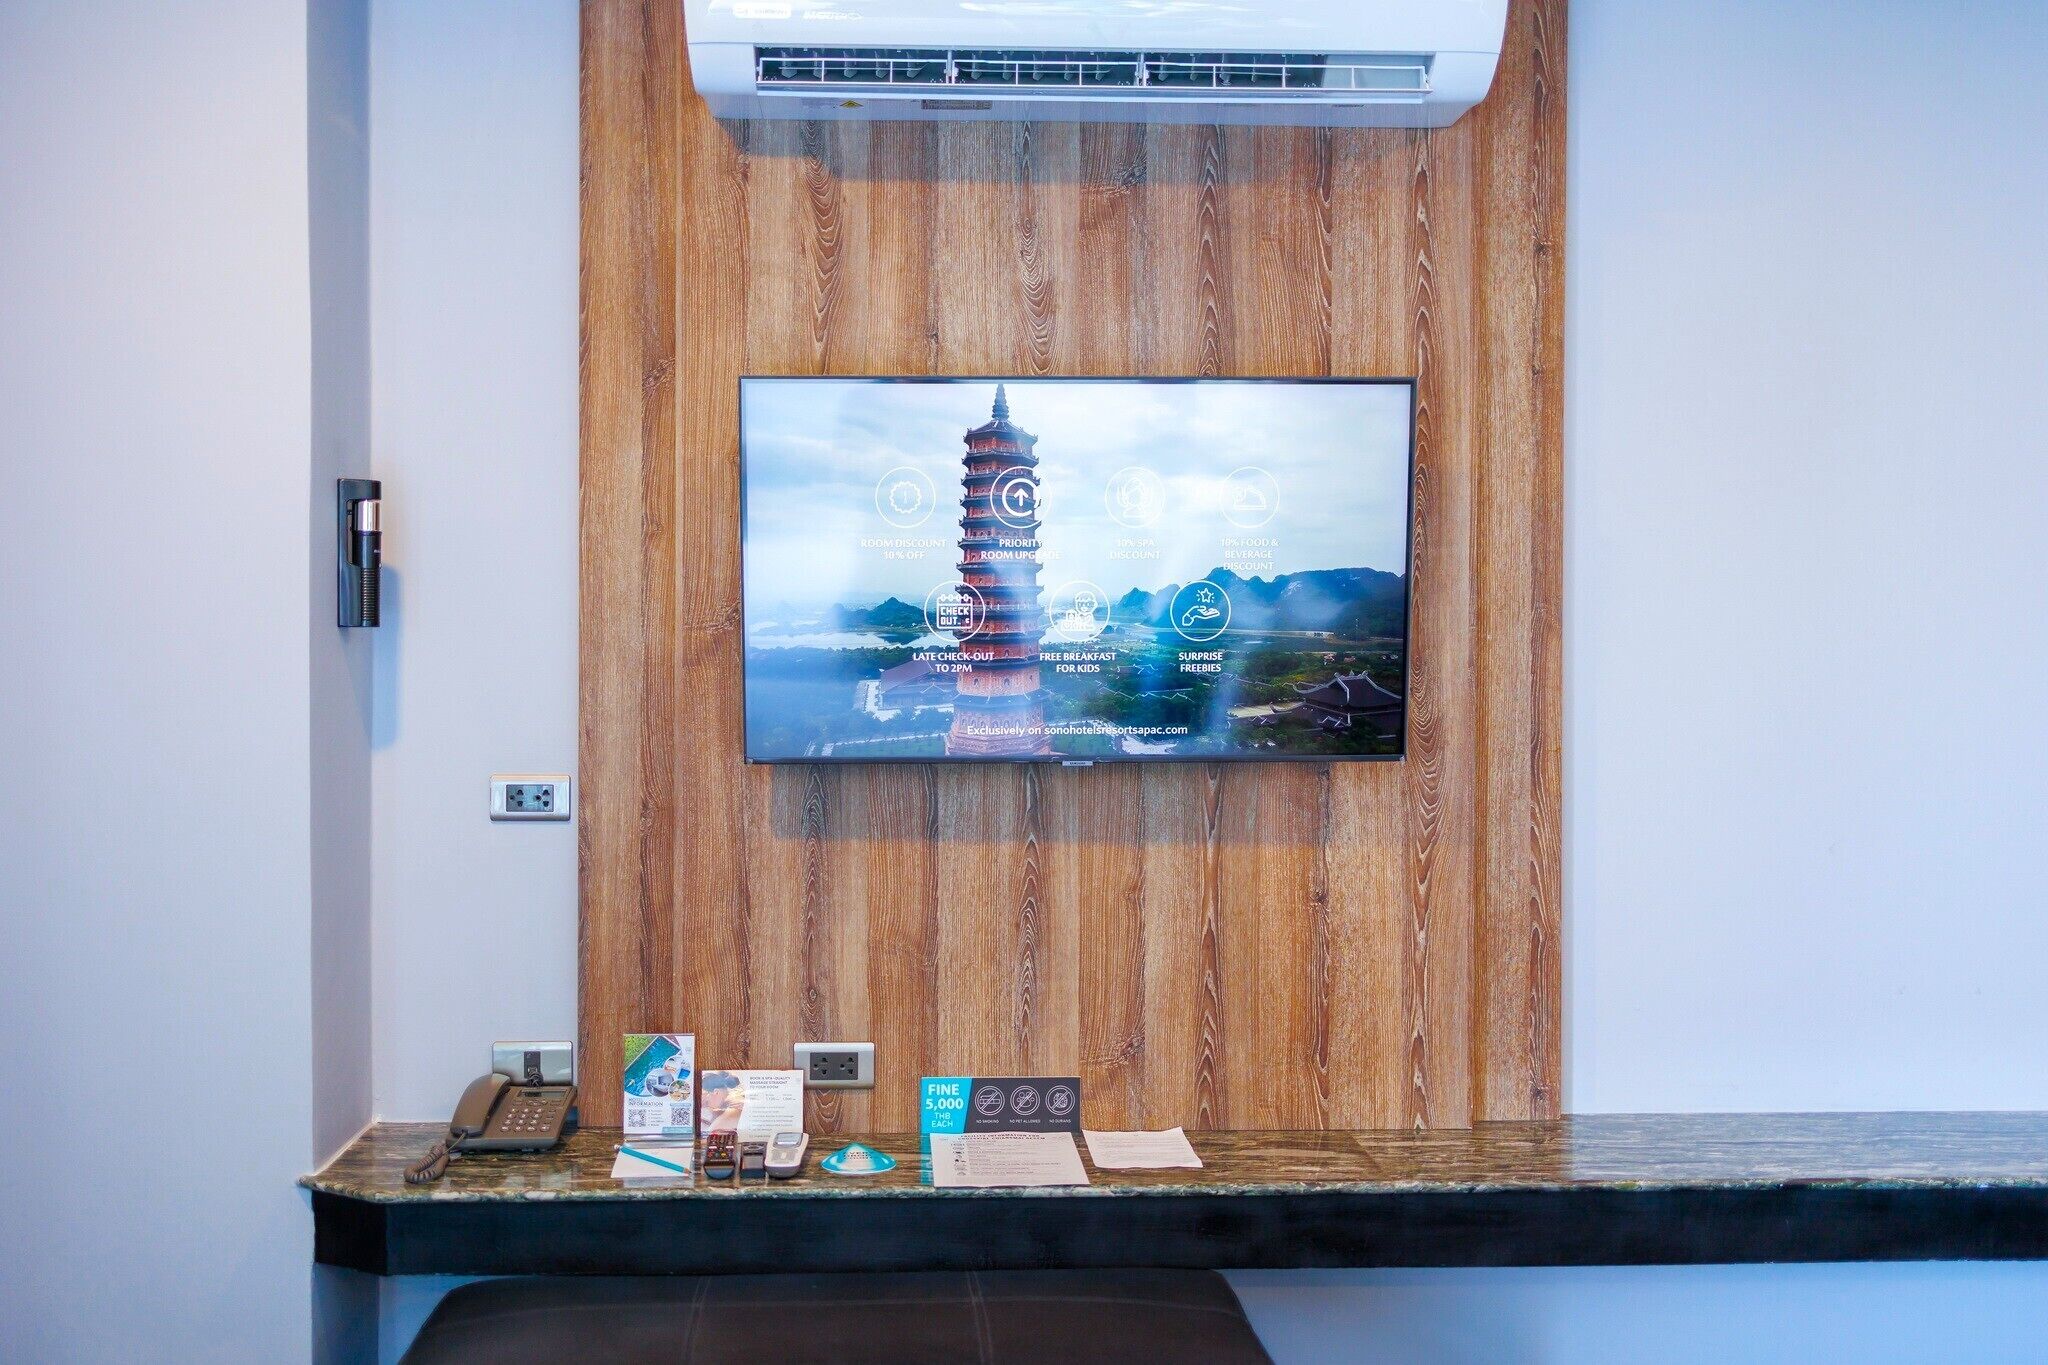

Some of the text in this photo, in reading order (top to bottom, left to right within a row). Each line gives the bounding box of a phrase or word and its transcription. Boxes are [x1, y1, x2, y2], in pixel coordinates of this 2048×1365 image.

[861, 538, 947, 548] ROOM DISCOUNT
[999, 538, 1043, 548] PRIORITY
[1240, 538, 1268, 548] FOOD
[1269, 538, 1279, 548] &
[906, 550, 926, 560] OFF
[980, 550, 1013, 560] ROOM
[1109, 550, 1160, 560] DISCOUNT
[1224, 550, 1273, 559] BEVERAGE
[1223, 562, 1275, 571] DISCOUNT
[940, 606, 970, 616] CHECK
[912, 652, 995, 661] LATE CHECK-OUT
[1039, 652, 1117, 661] FREE BREAKFAST
[1178, 652, 1223, 661] SURPRISE
[935, 664, 973, 673] TO 2PM
[1056, 664, 1101, 673] FOR KIDS
[1180, 664, 1222, 673] FREEBIES
[967, 724, 1188, 737] Exclusively on sonohotelsresortsapac.com
[928, 1084, 960, 1096] FINE
[925, 1098, 964, 1111] 5,000
[935, 1112, 951, 1120] THB
[931, 1120, 953, 1128] EACH
